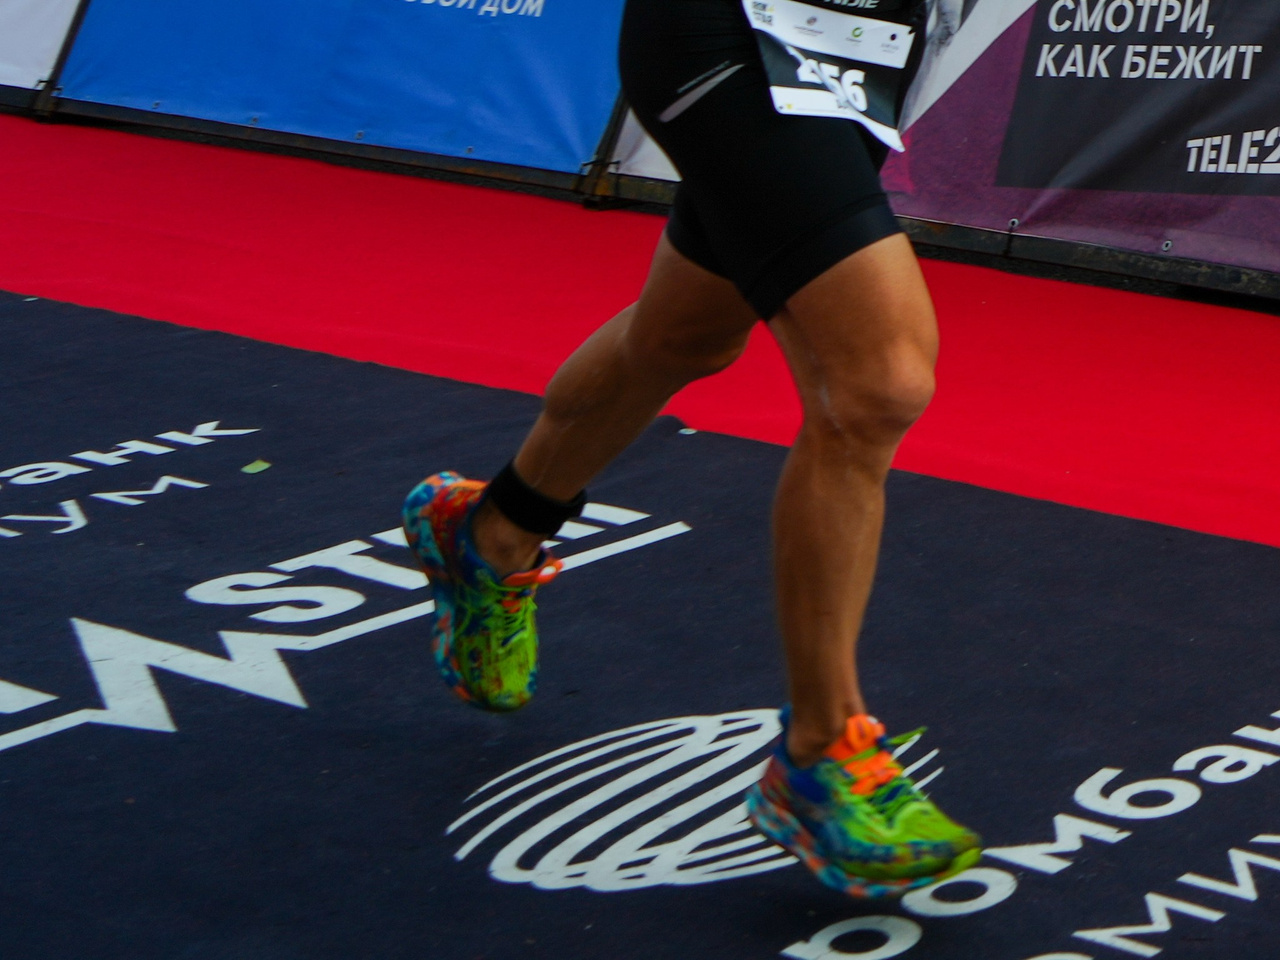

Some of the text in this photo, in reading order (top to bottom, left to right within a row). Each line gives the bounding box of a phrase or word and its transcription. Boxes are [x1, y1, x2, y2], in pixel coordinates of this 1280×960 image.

[1035, 43, 1263, 80] КАК БЕЖИТ
[0, 420, 262, 486] анк
[0, 475, 211, 538] ум
